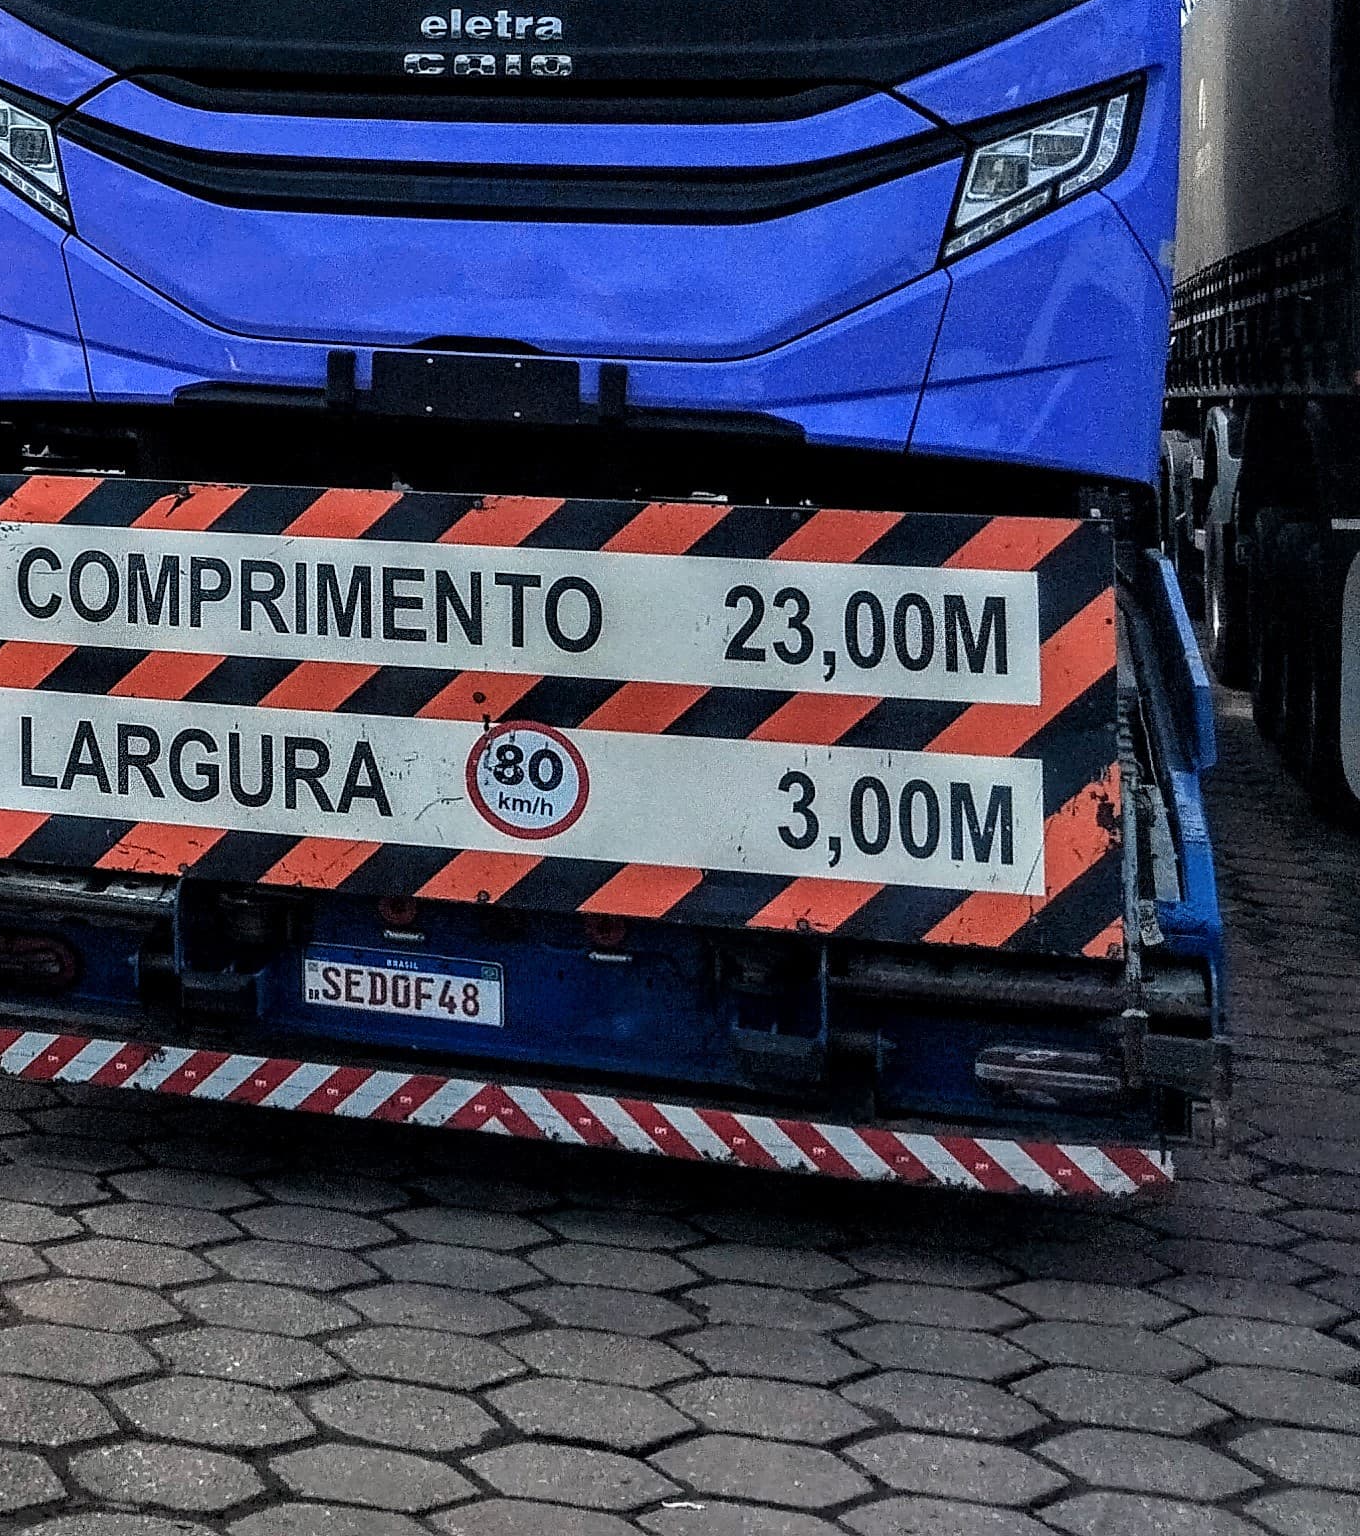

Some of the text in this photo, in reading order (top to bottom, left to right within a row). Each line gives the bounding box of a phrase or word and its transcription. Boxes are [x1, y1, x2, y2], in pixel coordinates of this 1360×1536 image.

[420, 8, 563, 41] eletra
[403, 52, 573, 76] CAIO
[16, 547, 1008, 682] COMPRIMENTO 23,00M
[493, 744, 564, 792] 80
[19, 715, 1014, 868] LARGURA 3,00M
[498, 791, 554, 817] km/h
